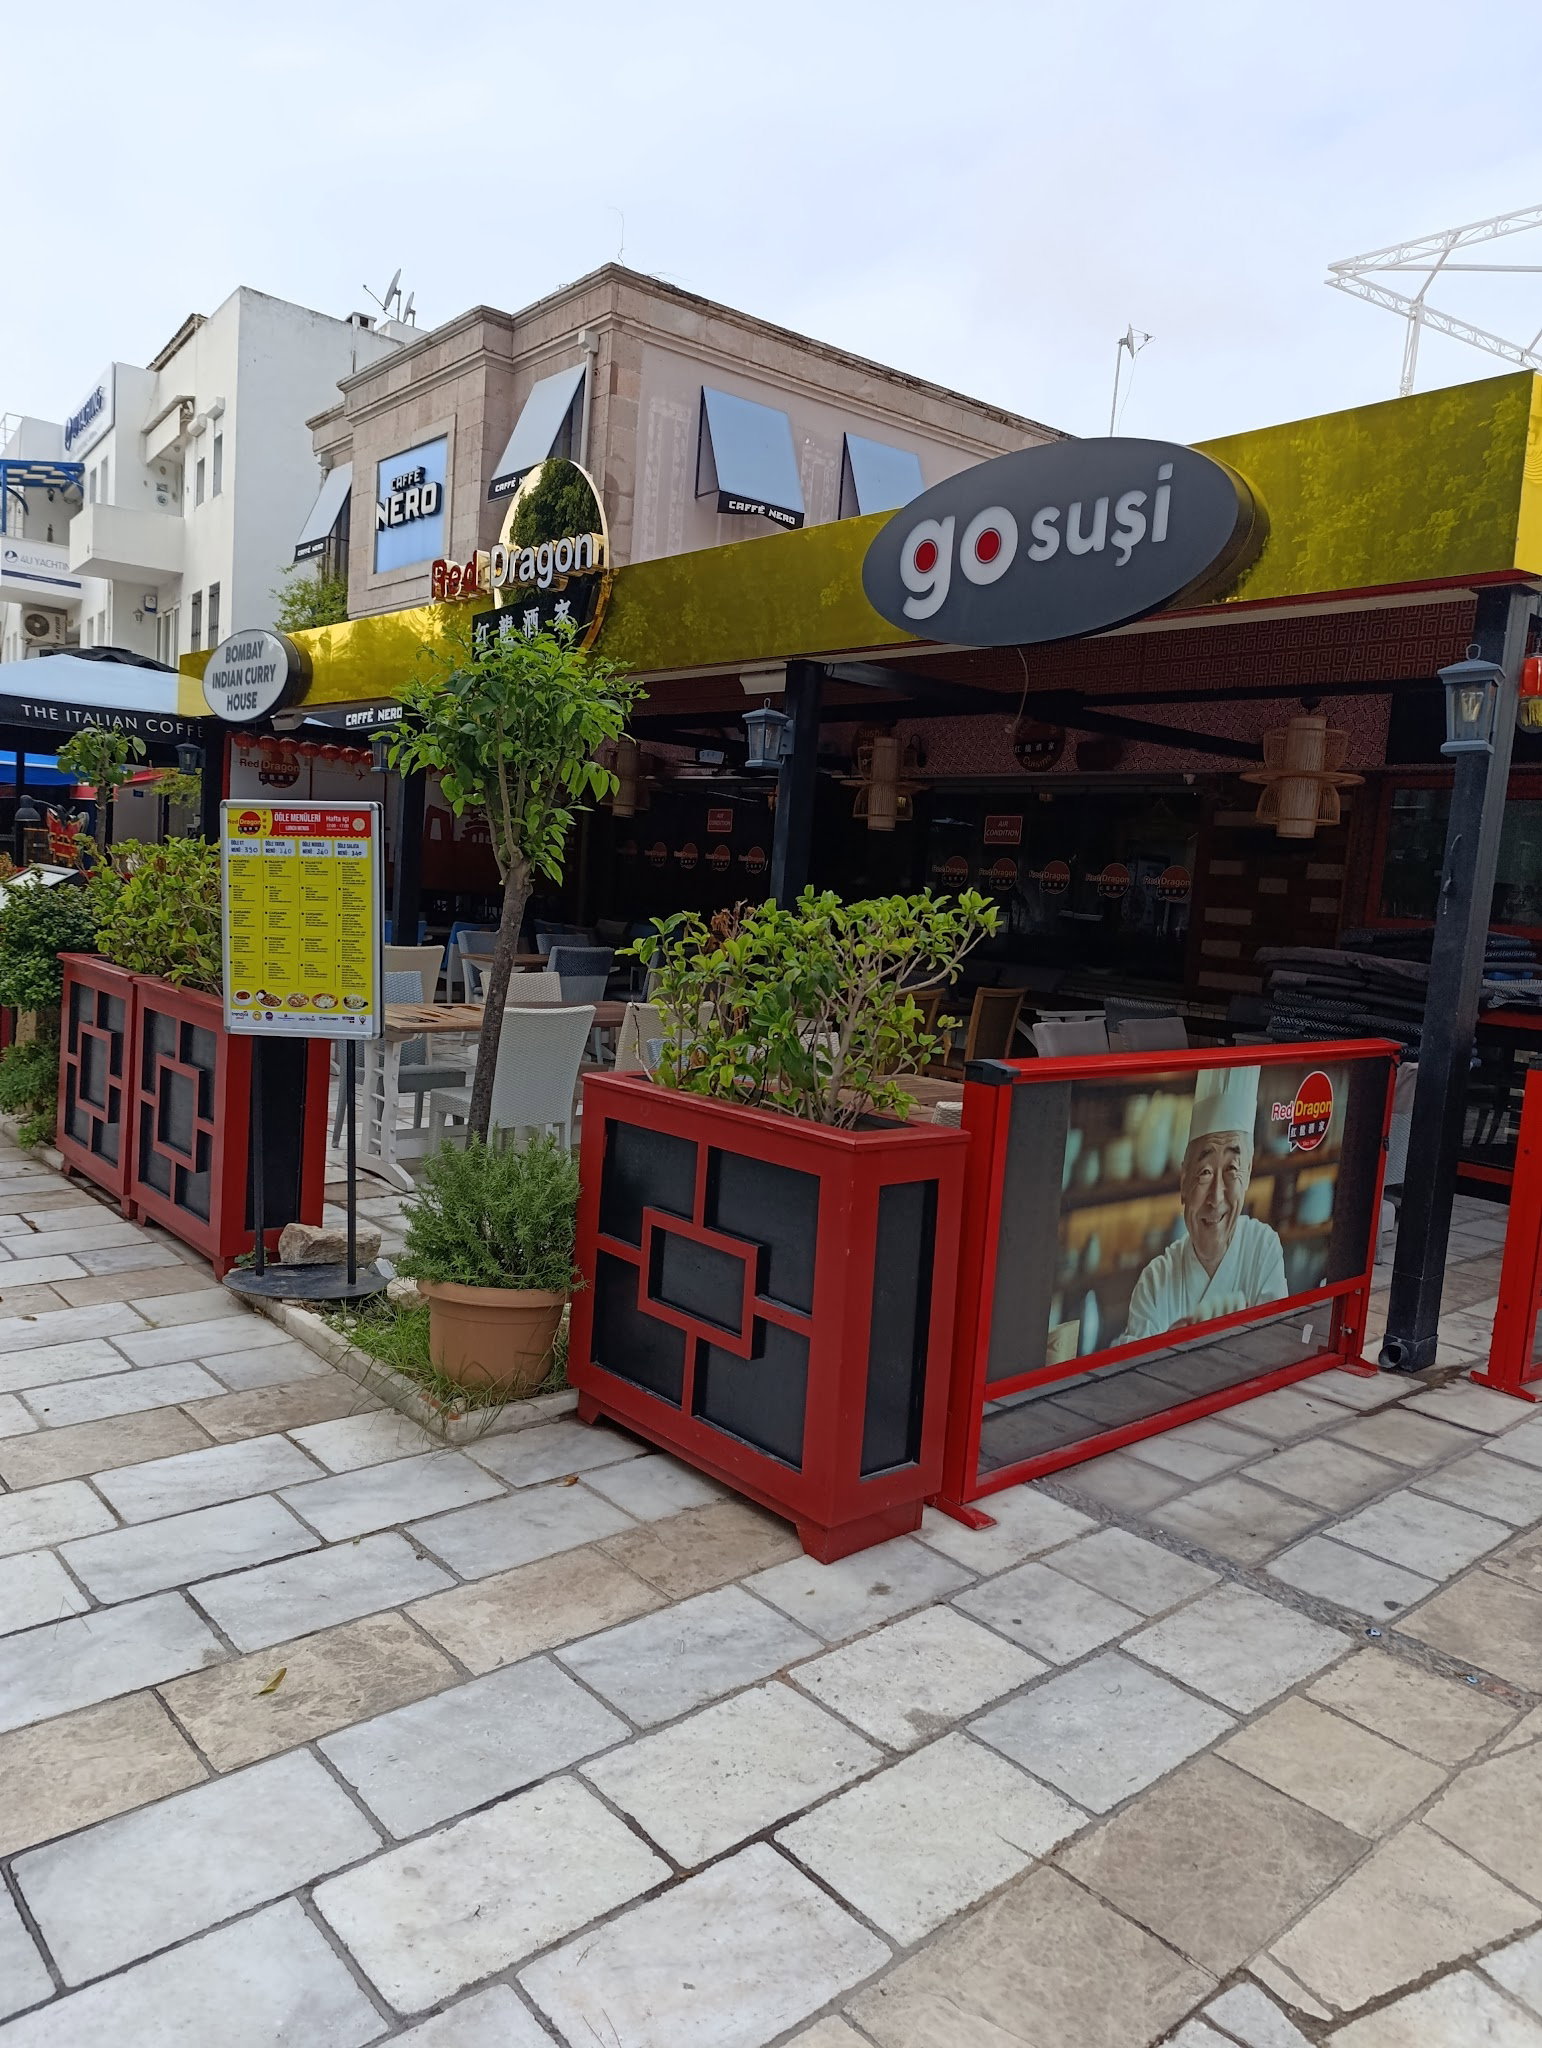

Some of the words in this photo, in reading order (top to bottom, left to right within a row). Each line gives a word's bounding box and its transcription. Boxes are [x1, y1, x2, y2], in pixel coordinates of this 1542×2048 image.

[376, 482, 440, 530] NERO
[768, 508, 796, 525] NERO
[312, 543, 324, 552] NERO
[900, 506, 1017, 620] go
[1027, 463, 1173, 566] suşi
[432, 549, 478, 601] Red
[490, 533, 594, 588] Dragon
[225, 640, 264, 663] BOMBAY
[212, 669, 243, 689] INDIAN
[245, 664, 277, 685] CURRY
[227, 692, 258, 712] HOUSE
[20, 704, 59, 721] THE
[65, 710, 138, 729] ITALIAN
[377, 706, 403, 722] NERO
[240, 758, 260, 768] Red
[262, 760, 300, 773] Dragon
[986, 829, 1020, 837] CONDITION
[945, 866, 969, 874] Dragon
[1044, 871, 1069, 880] Dragon
[1101, 874, 1129, 883] Dragon
[1160, 877, 1190, 886] Dragon
[1271, 1101, 1295, 1121] Red
[1295, 1100, 1332, 1118] Dragon
